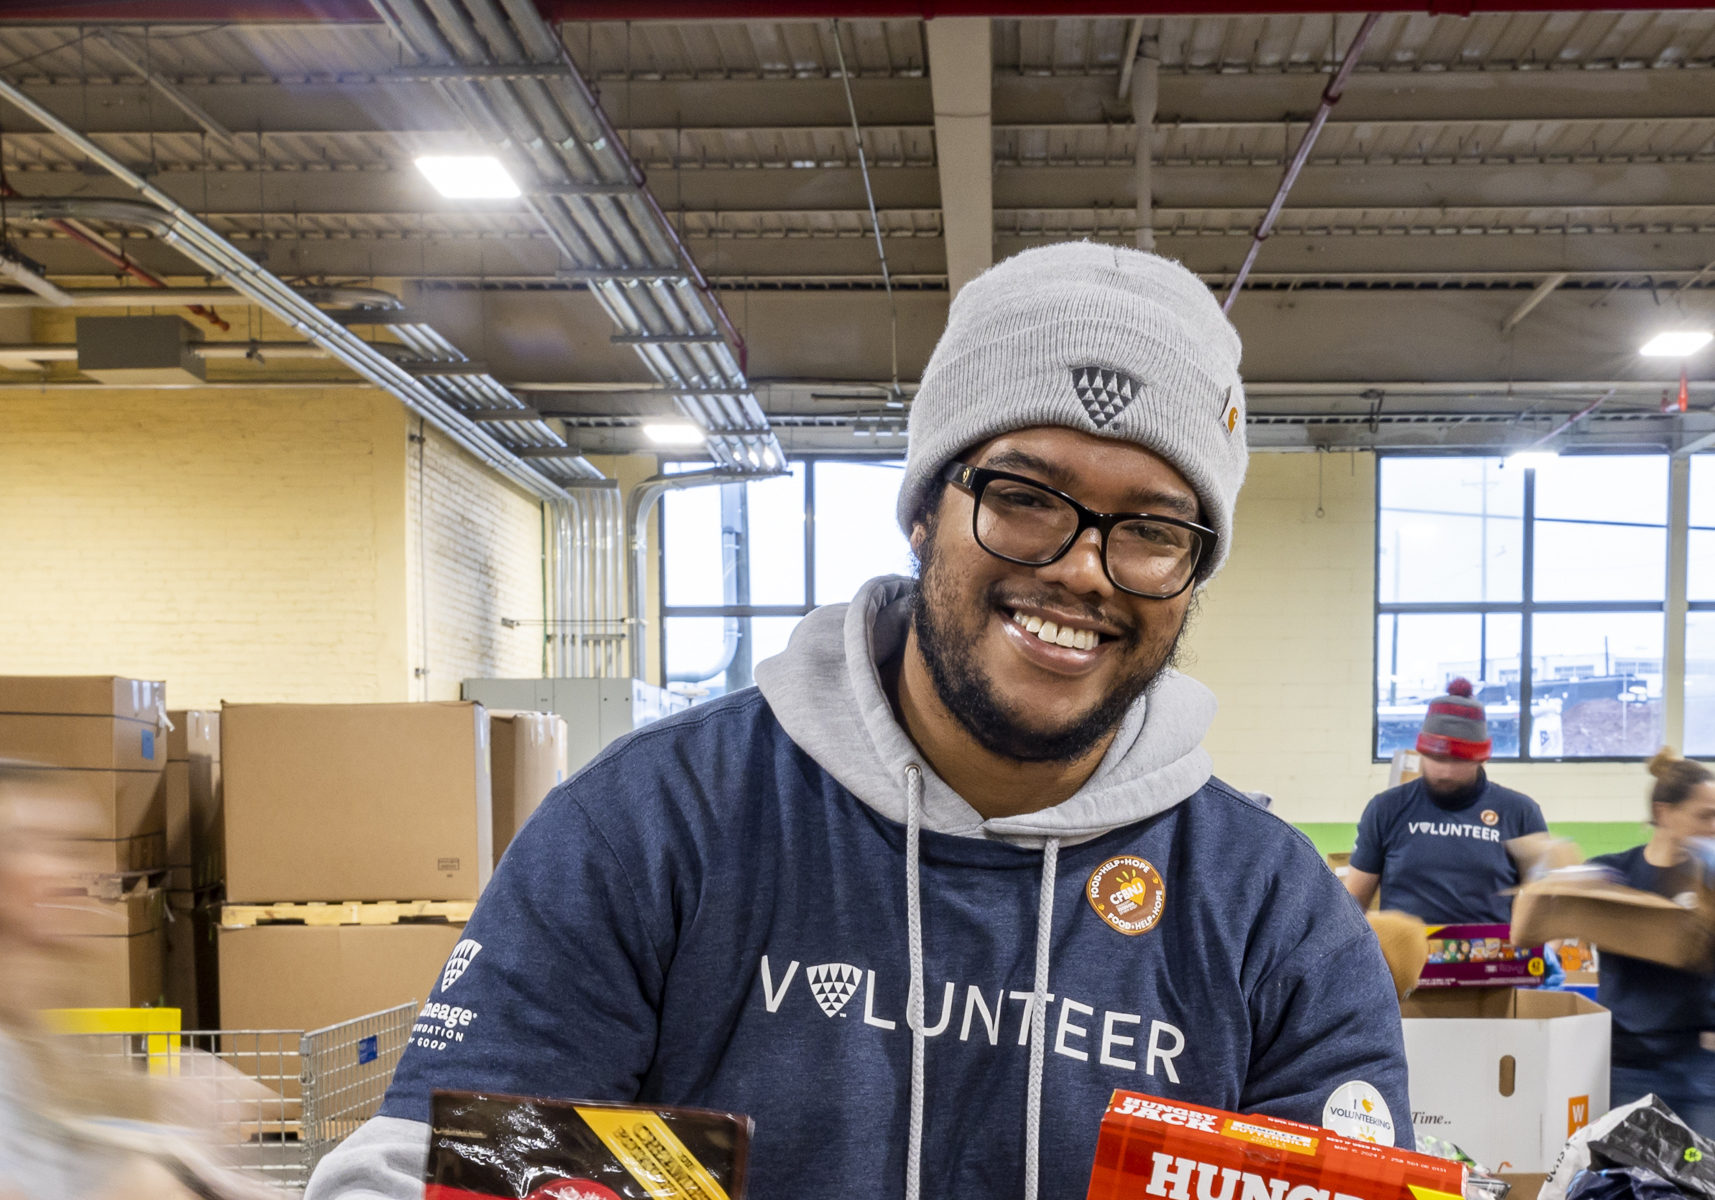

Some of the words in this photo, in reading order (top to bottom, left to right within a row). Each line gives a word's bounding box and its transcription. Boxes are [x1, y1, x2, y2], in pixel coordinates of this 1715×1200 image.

[1090, 874, 1102, 898] FOOD
[1100, 860, 1120, 874] HELP
[1125, 859, 1150, 873] HOPE
[1110, 882, 1144, 904] CFBNJ
[1107, 913, 1131, 930] FOOD
[1135, 916, 1153, 930] HELP
[1152, 890, 1162, 915] HOPE
[420, 998, 473, 1028] ineage
[413, 1024, 464, 1042] UNDATION
[417, 1037, 446, 1050] GOOD
[1123, 1096, 1218, 1122] HUNGRY
[1330, 1106, 1391, 1130] VOLUNTEERING
[1230, 1126, 1311, 1147] BUTTERMILK
[1241, 1124, 1303, 1140] COMPLETE
